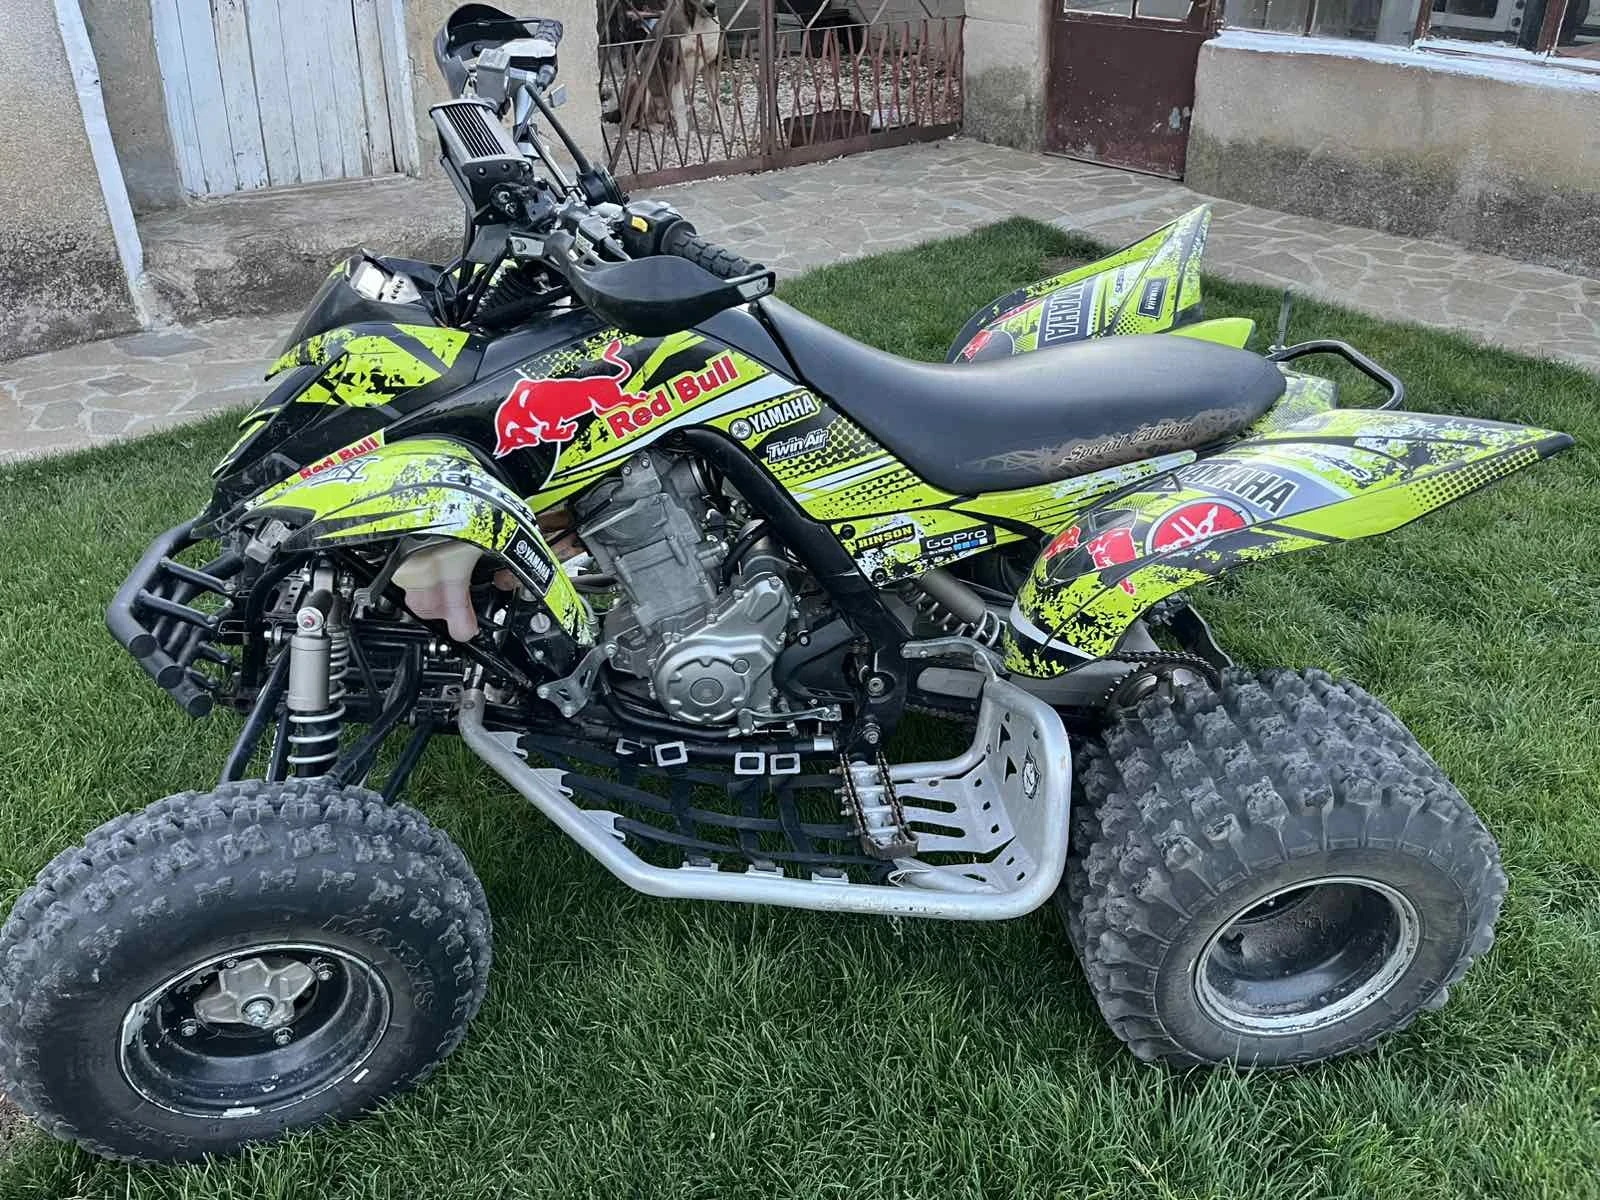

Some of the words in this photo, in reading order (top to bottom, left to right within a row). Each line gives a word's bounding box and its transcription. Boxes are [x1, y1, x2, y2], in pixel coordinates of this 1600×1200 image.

[607, 388, 672, 439] Red
[673, 355, 739, 403] Bull
[749, 393, 816, 433] YAMAHA
[299, 456, 336, 480] Red
[338, 435, 381, 461] Bull
[767, 438, 804, 459] Twin
[804, 430, 827, 449] Air
[857, 526, 914, 549] HINSON
[926, 529, 987, 549] GoPro
[523, 545, 552, 582] YAMAHA
